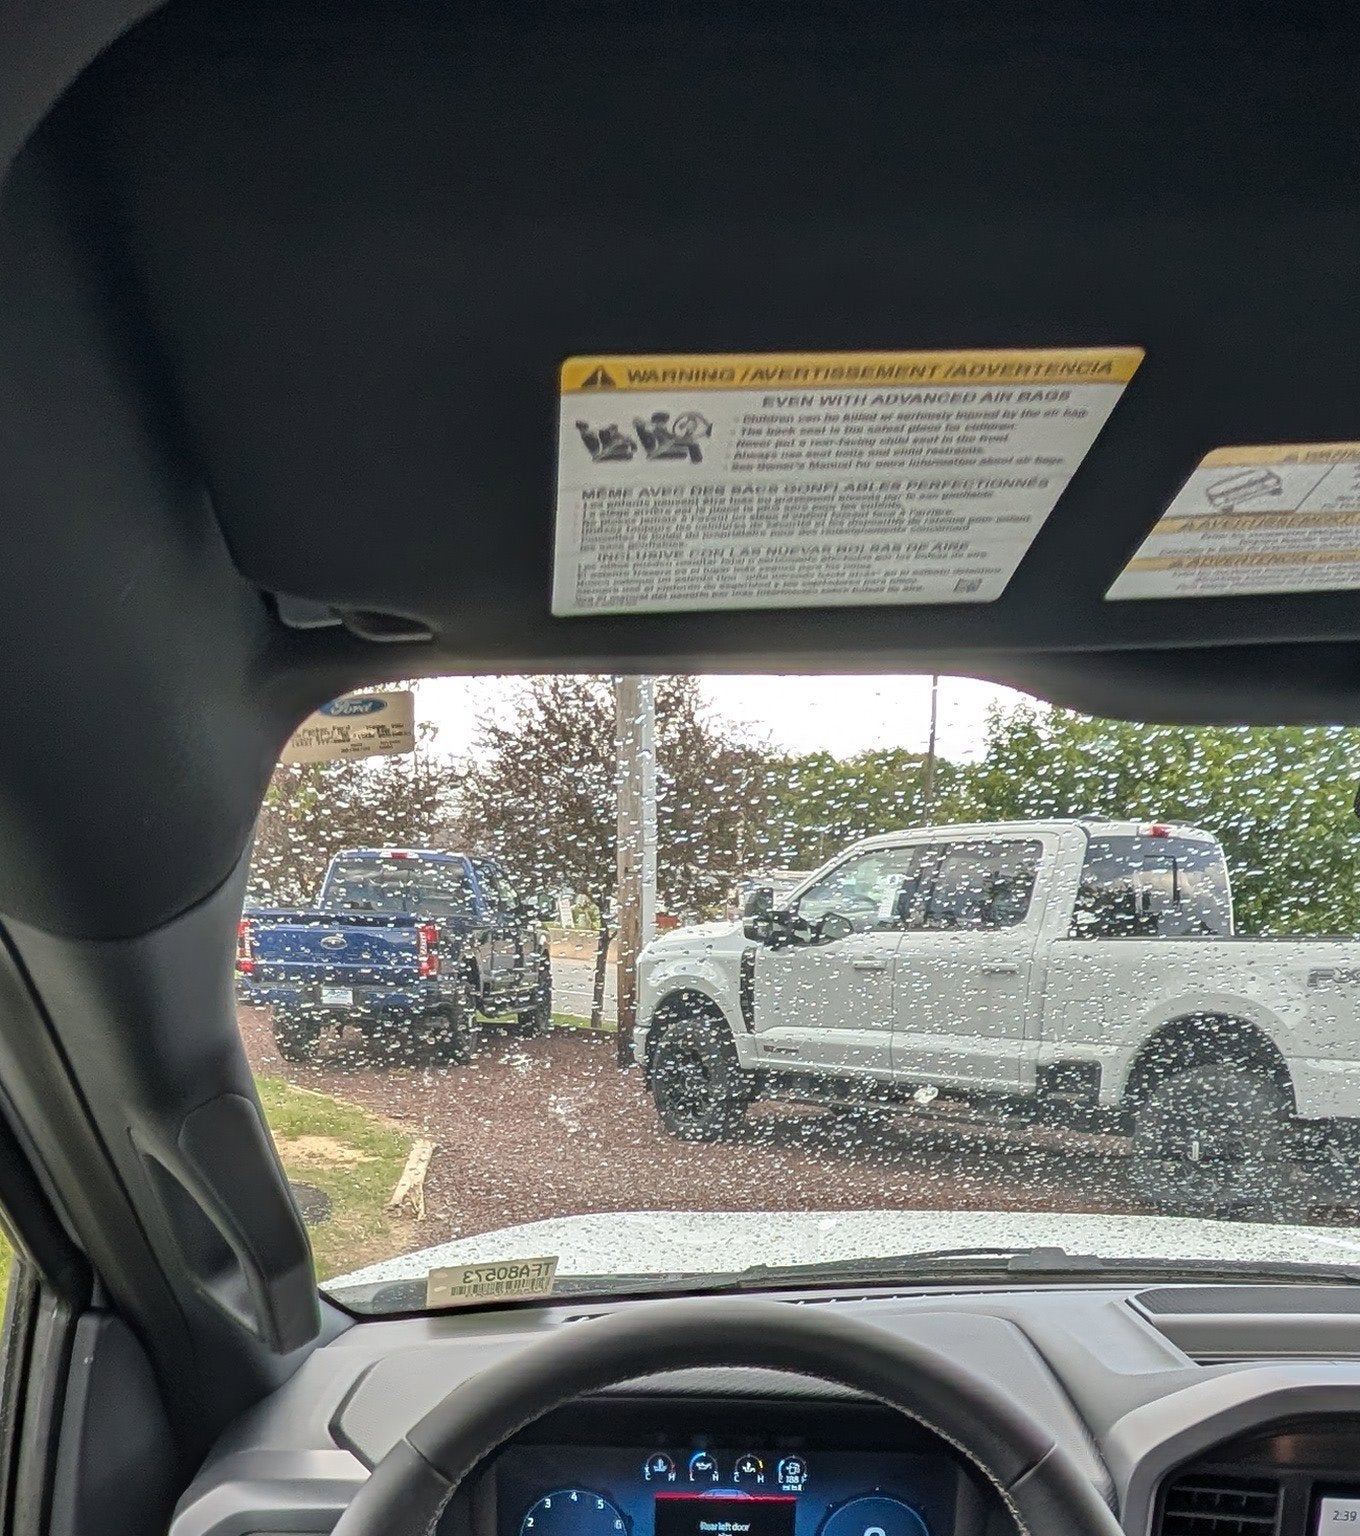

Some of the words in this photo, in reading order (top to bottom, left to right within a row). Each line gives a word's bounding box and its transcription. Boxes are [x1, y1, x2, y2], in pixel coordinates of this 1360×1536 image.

[627, 368, 736, 383] WARNING
[762, 394, 815, 408] EVEN
[819, 393, 868, 407] WITH
[870, 391, 978, 405] ADVANCED
[570, 1491, 578, 1502] 4
[544, 1499, 552, 1509] 3
[597, 1499, 605, 1510] 5
[527, 1517, 535, 1528] 2
[614, 1519, 623, 1530] 6
[700, 1521, 718, 1531] Rear
[718, 1521, 731, 1531] left
[731, 1523, 751, 1532] door
